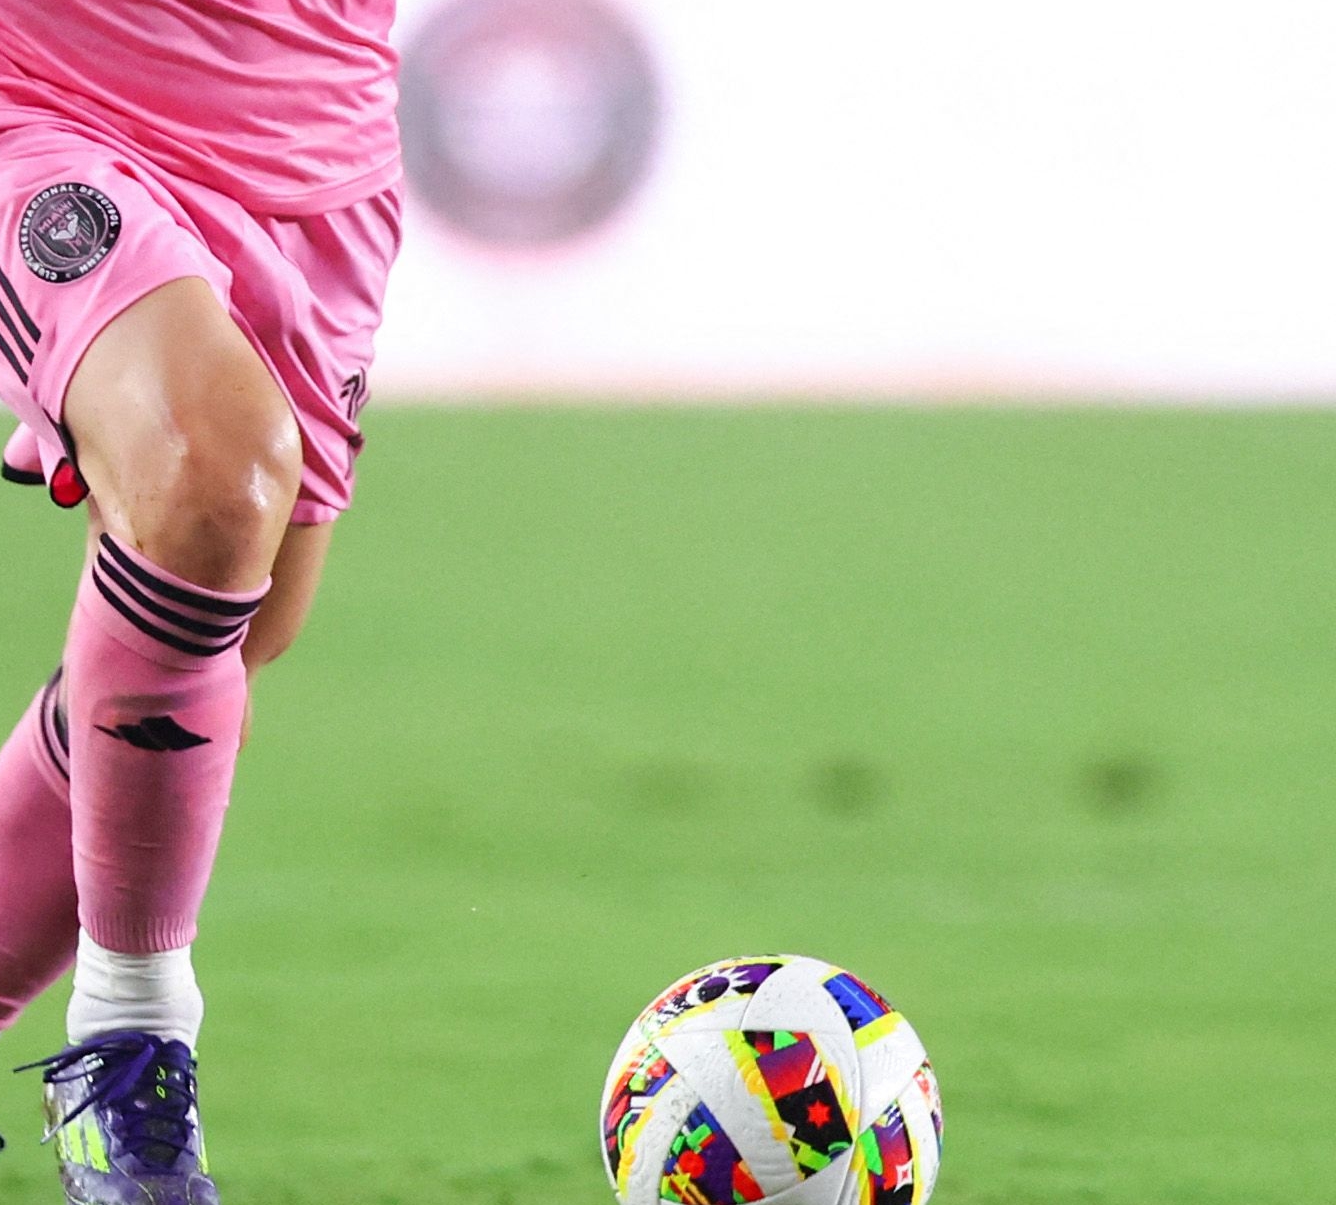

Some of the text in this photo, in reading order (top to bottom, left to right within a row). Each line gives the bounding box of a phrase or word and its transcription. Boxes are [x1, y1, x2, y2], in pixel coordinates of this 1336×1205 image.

[79, 186, 94, 196] DE
[21, 185, 75, 262] INTERNACIONAL
[39, 200, 74, 233] MIAMI
[32, 262, 57, 280] CLUB
[79, 246, 108, 274] MMXX
